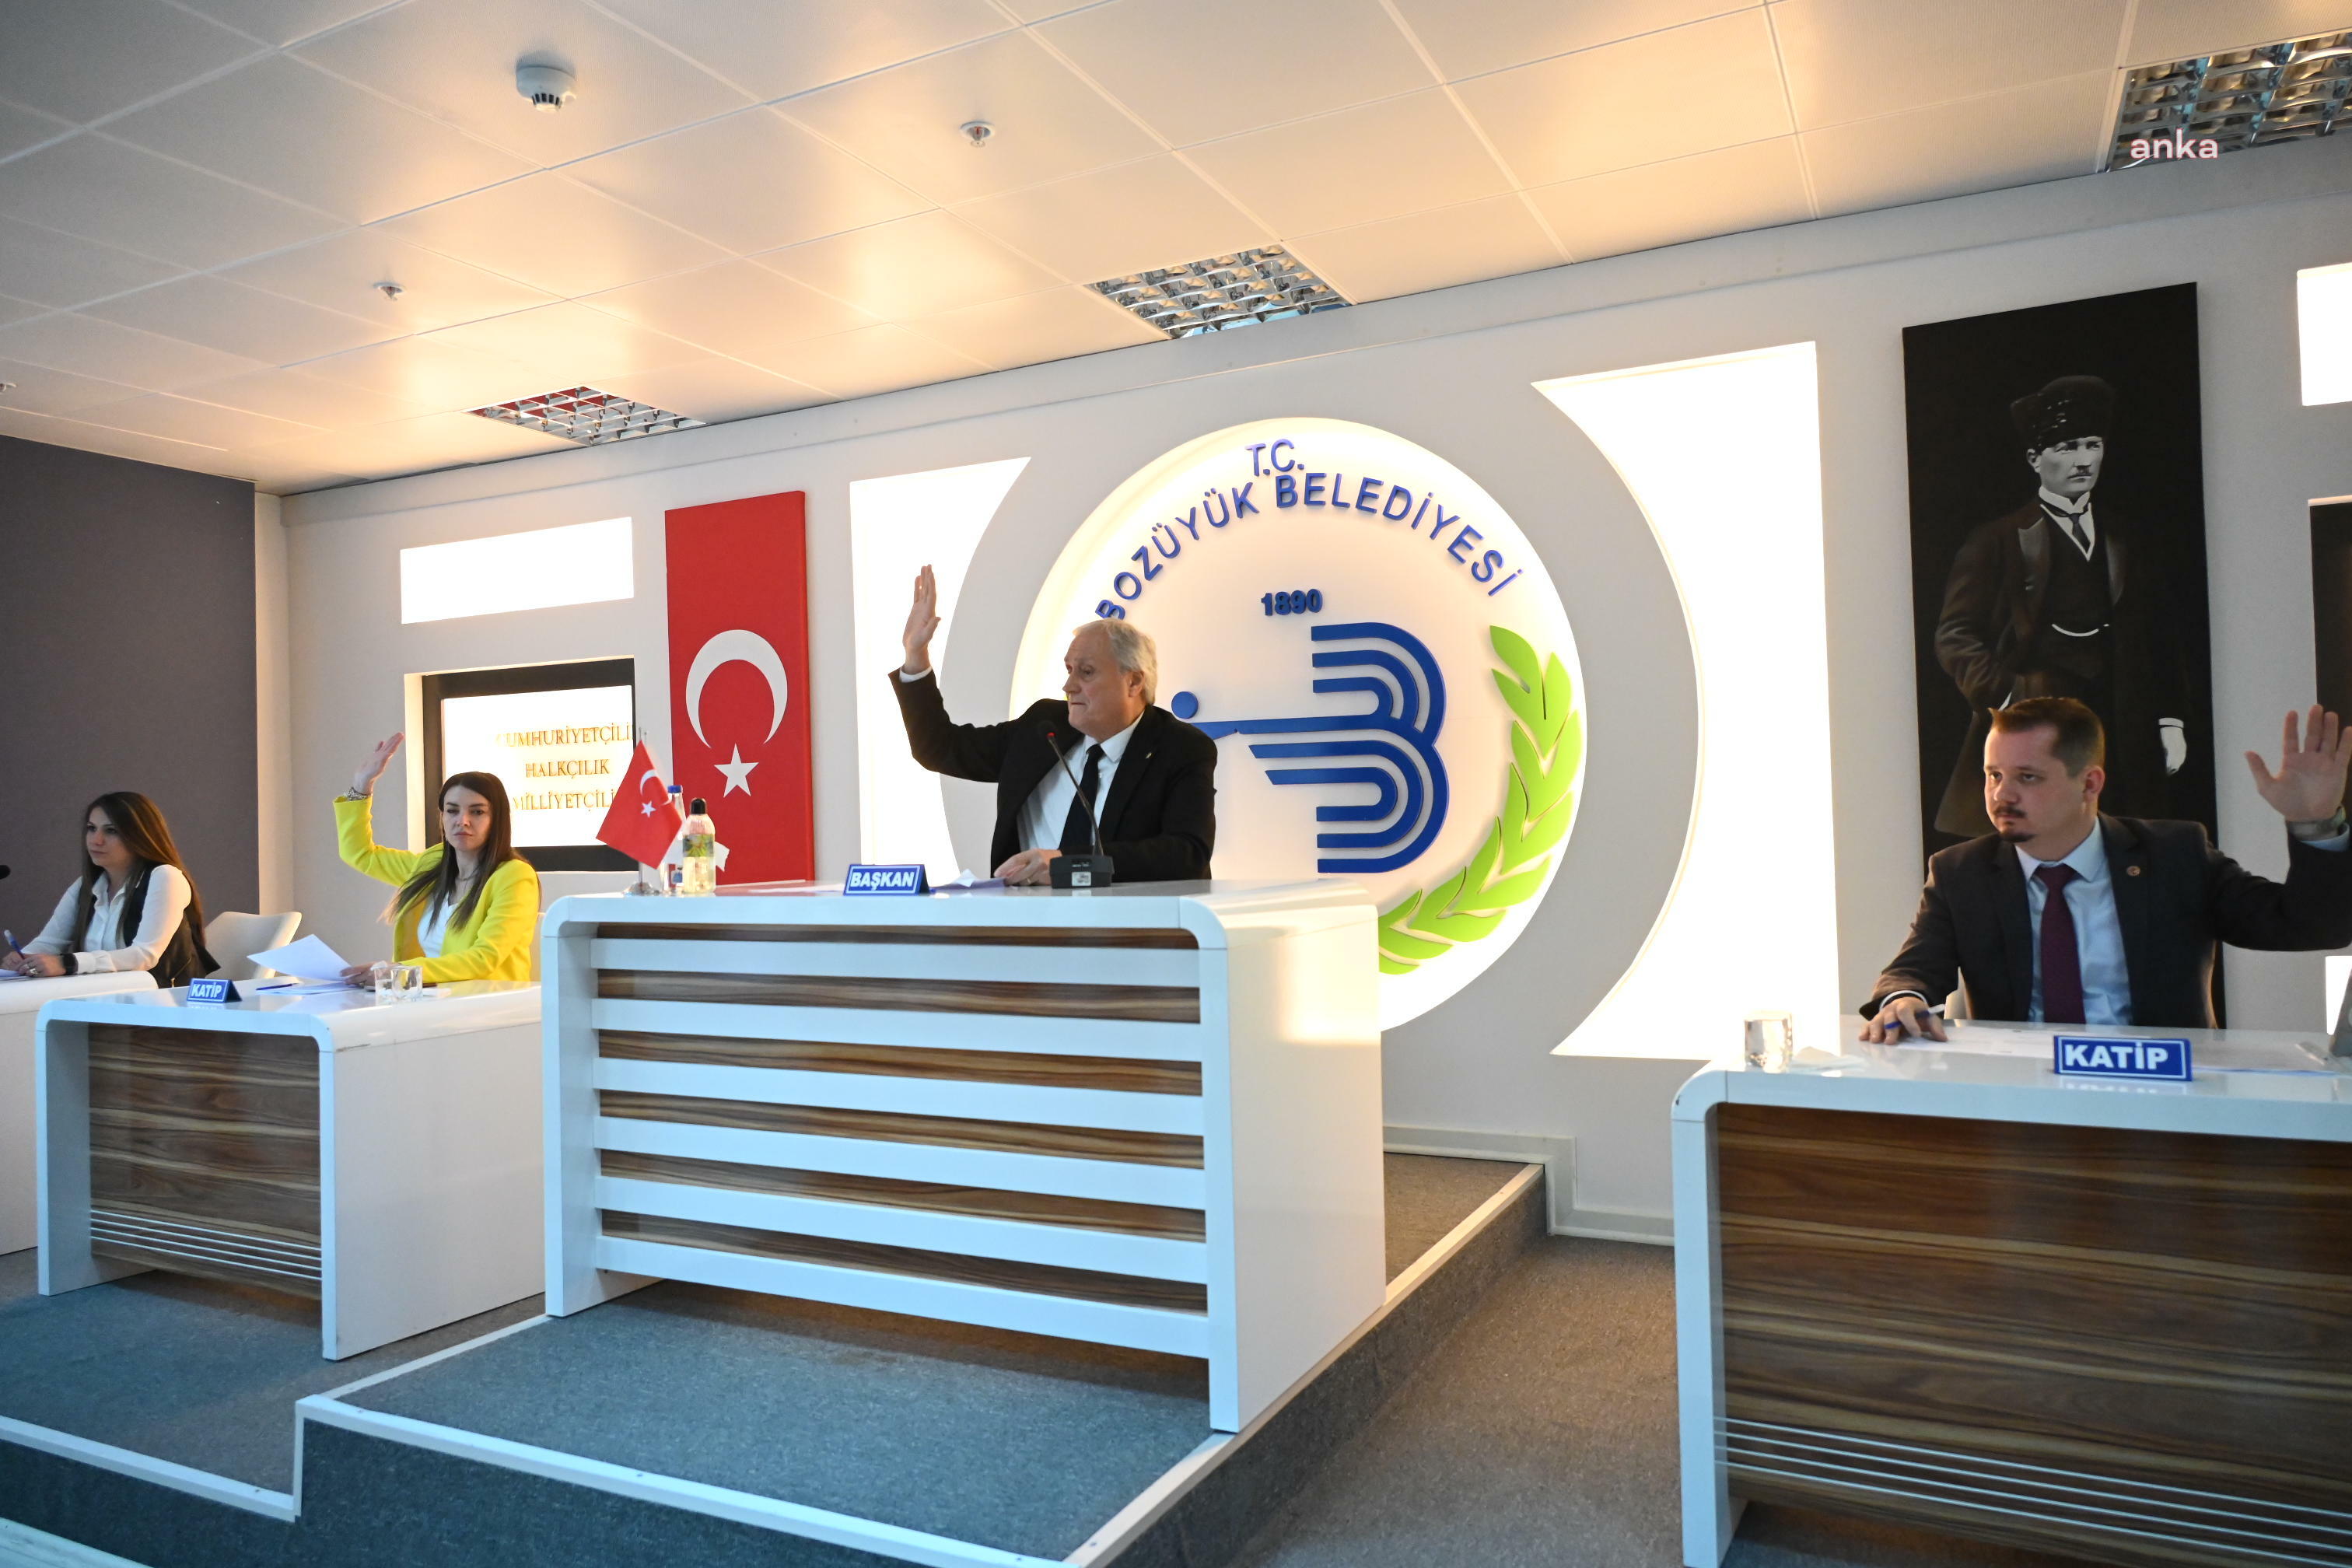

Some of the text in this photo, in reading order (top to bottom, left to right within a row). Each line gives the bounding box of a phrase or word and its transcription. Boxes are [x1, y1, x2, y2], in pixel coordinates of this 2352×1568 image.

[1244, 439, 1304, 477] T.C.
[1095, 472, 1524, 620] BOZÜYÜK BELEDİYESİ
[1261, 588, 1323, 616] 1890
[496, 722, 632, 747] CUMHURİYETÇİLİ
[526, 758, 611, 779] HALKÇILIK
[513, 789, 617, 812] MİLLİYETÇİLİ
[850, 871, 915, 891] BAŞKAN
[191, 982, 222, 998] KATİP
[2064, 1042, 2168, 1070] KATİP
